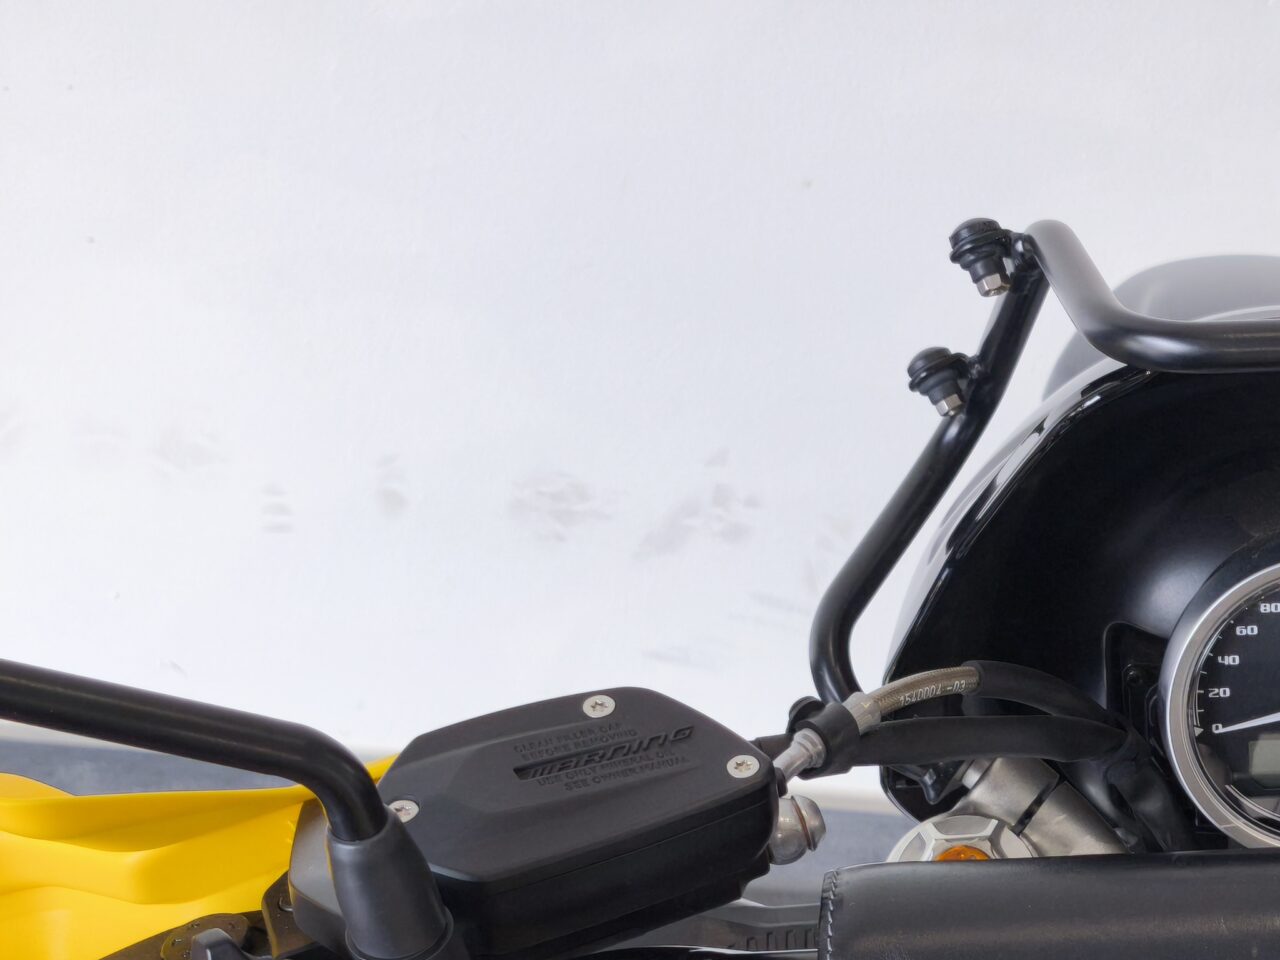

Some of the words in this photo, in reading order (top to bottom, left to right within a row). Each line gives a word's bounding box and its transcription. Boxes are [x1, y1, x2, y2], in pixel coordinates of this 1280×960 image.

[1236, 625, 1258, 636] 60
[1217, 655, 1240, 665] 40
[1208, 687, 1231, 698] 20
[1212, 723, 1223, 734] 0
